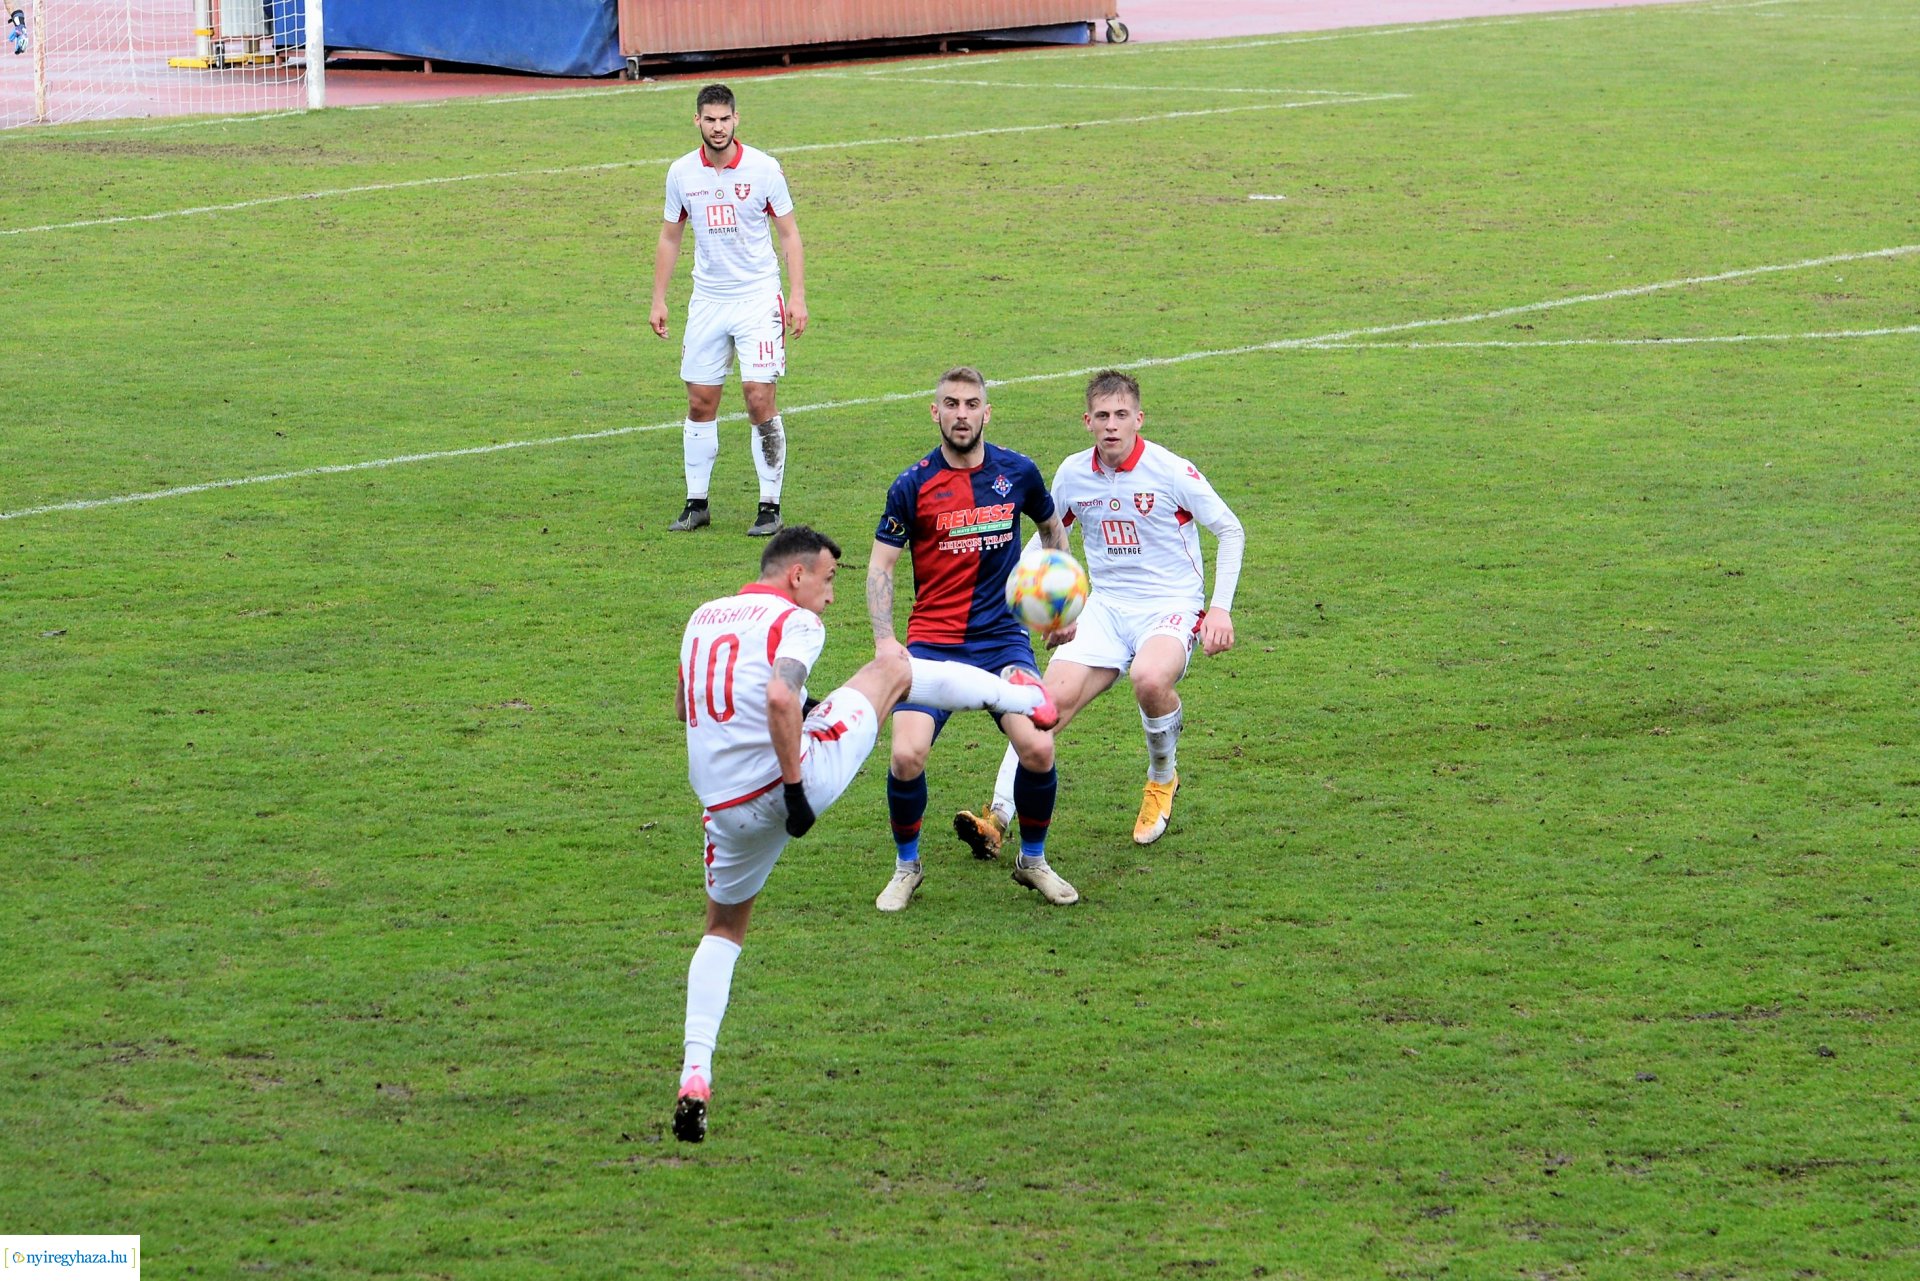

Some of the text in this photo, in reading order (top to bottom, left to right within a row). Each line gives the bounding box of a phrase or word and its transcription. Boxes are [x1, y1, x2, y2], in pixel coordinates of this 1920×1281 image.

[707, 205, 736, 227] HR
[759, 340, 774, 360] 14
[936, 502, 1015, 531] REVESZ
[1103, 521, 1139, 545] HR
[1107, 547, 1141, 555] MONTAGE
[688, 633, 740, 727] 10
